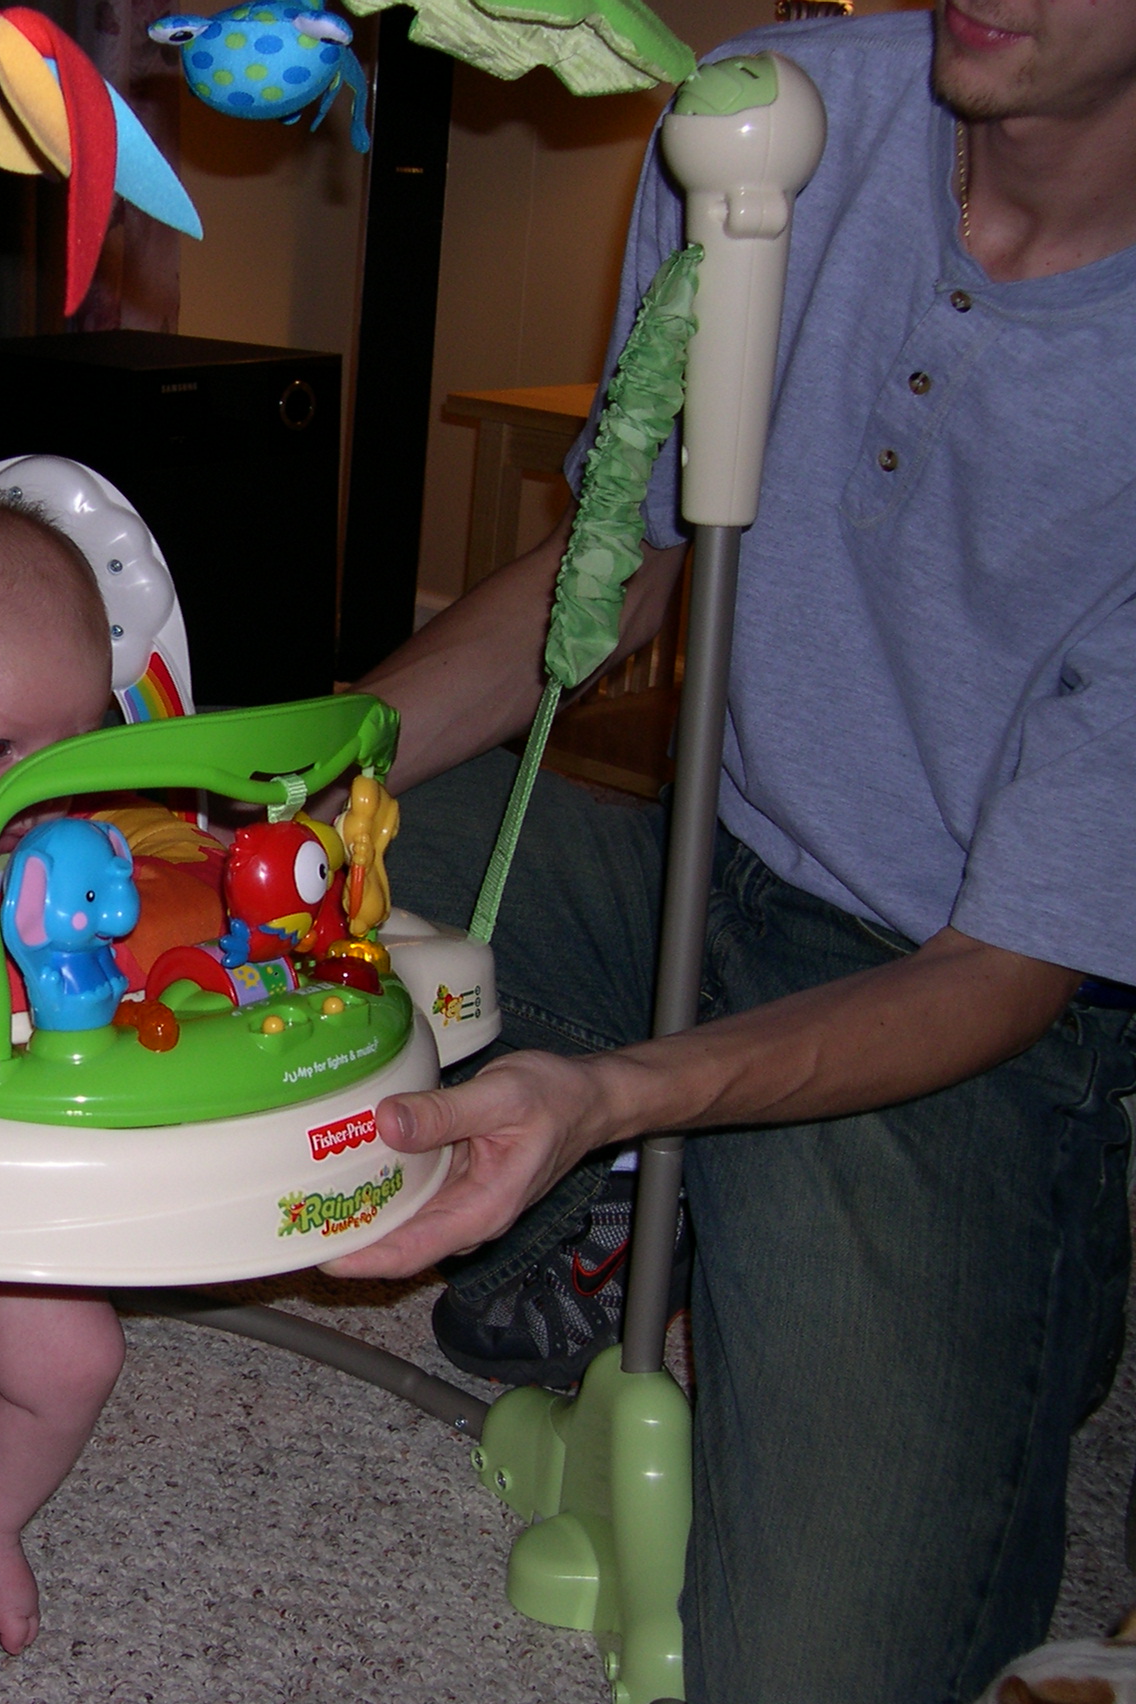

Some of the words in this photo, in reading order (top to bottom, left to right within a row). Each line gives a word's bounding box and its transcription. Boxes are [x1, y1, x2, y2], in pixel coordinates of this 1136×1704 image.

[313, 1061, 326, 1073] for
[326, 1054, 349, 1070] lights
[349, 1049, 356, 1061] &
[311, 1118, 375, 1151] Fisher-Price
